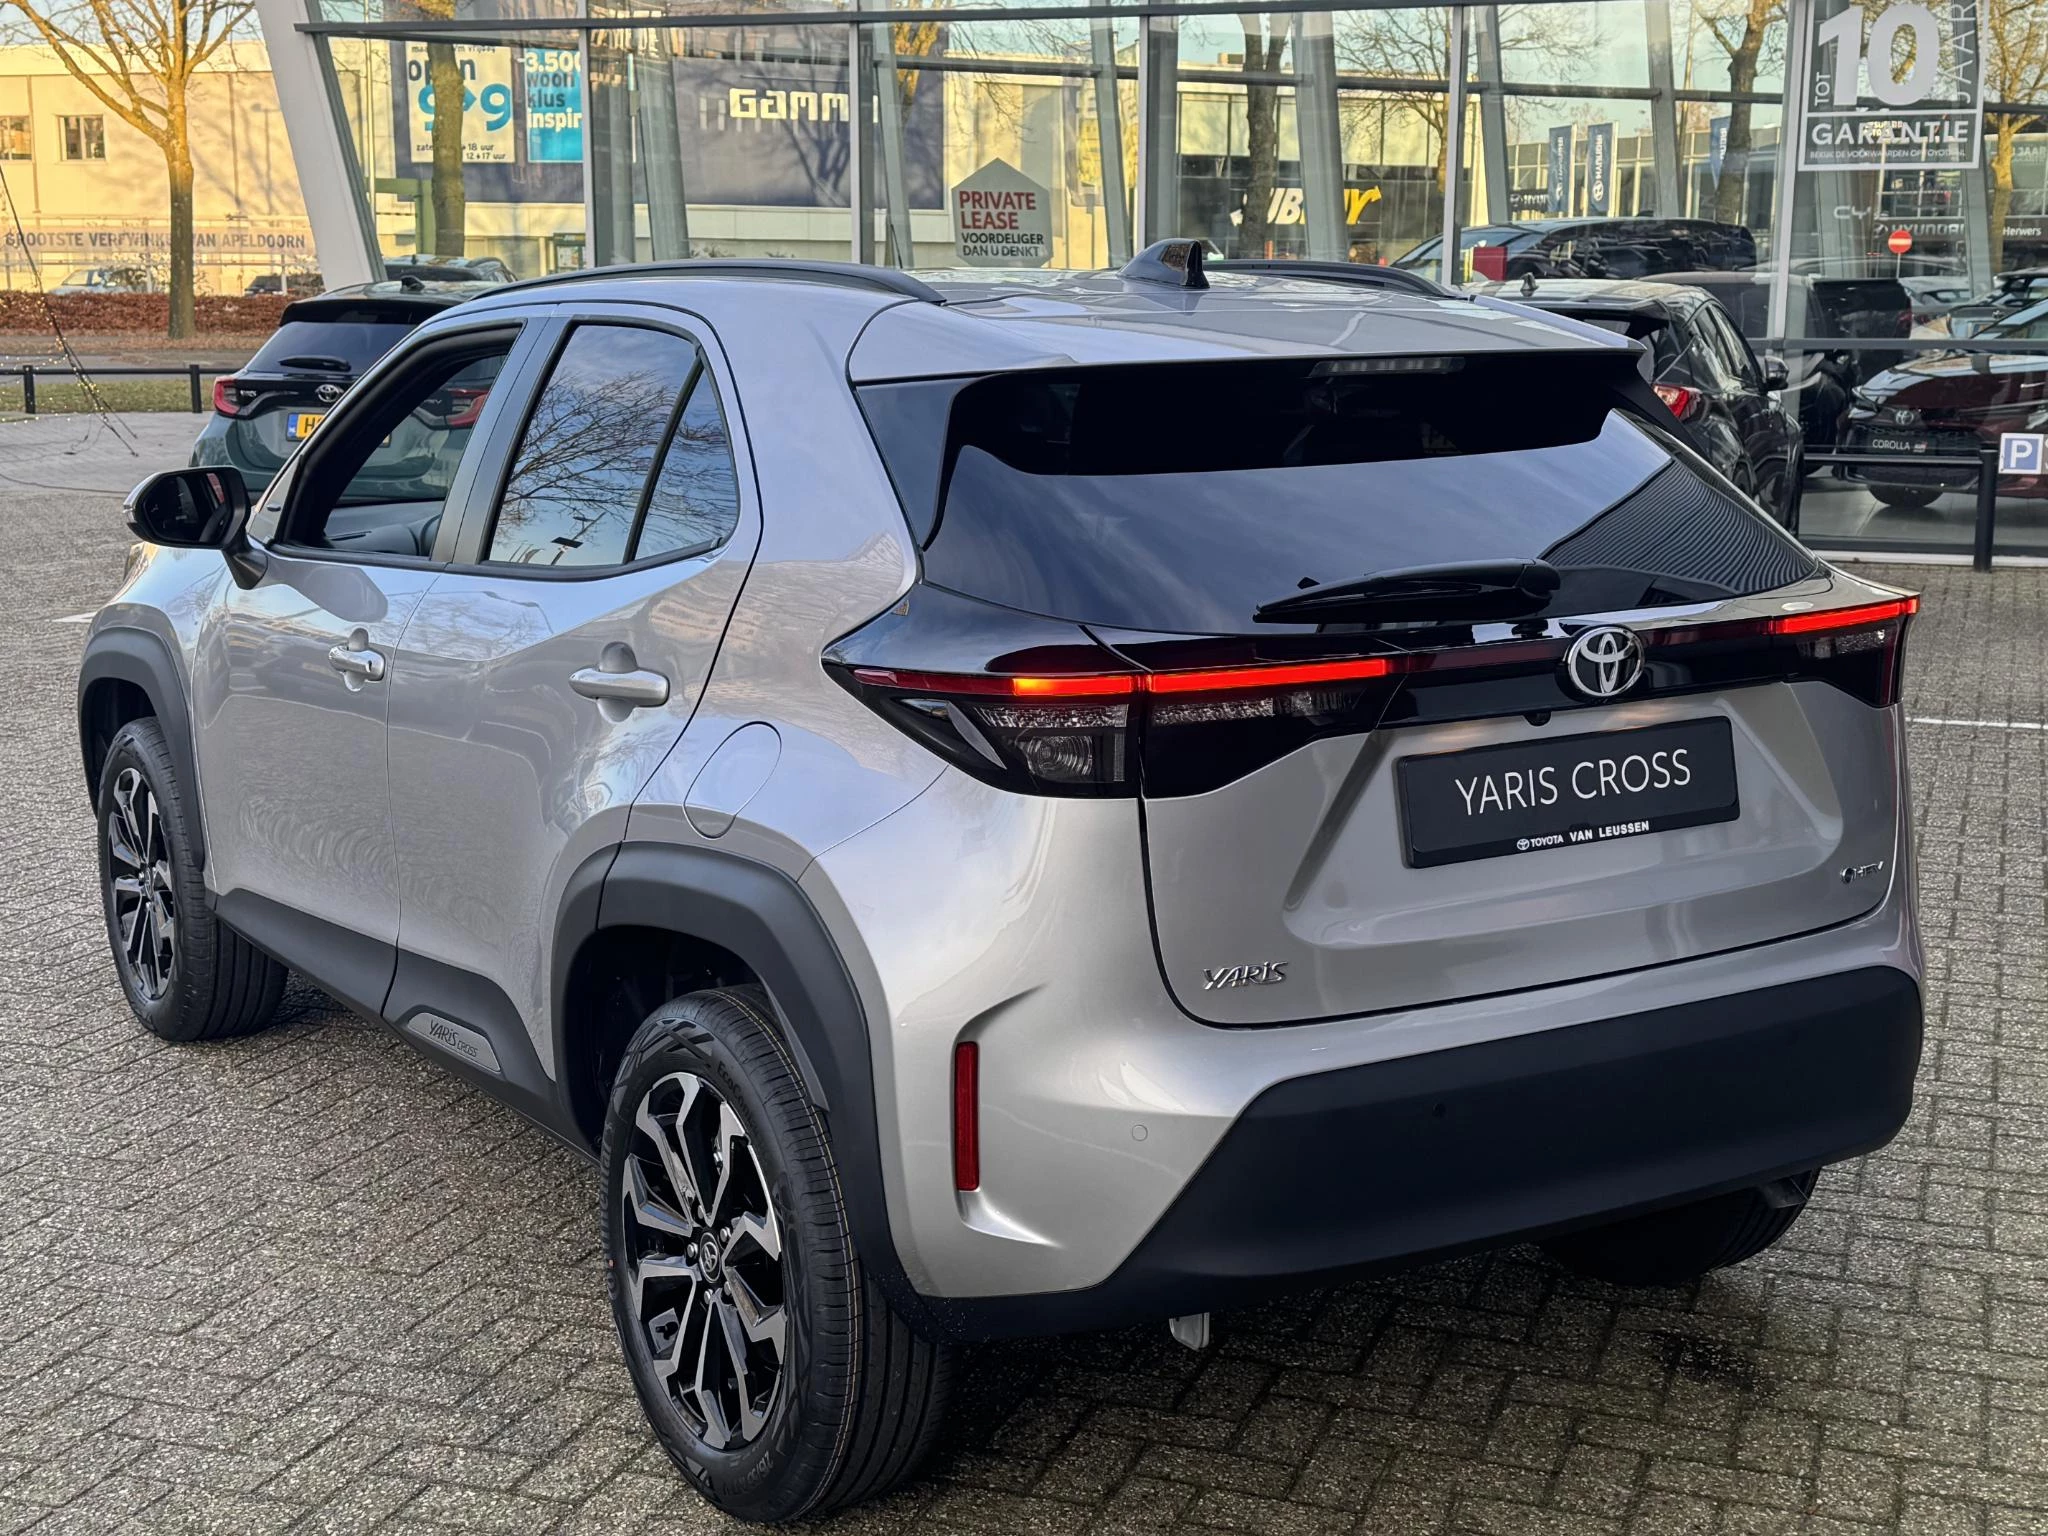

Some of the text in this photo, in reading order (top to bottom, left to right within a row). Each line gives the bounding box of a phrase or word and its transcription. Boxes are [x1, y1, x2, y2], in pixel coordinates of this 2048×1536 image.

[1818, 2, 1940, 106] 10
[1937, 0, 1976, 103] JAAR
[1815, 72, 1831, 107] TOT
[480, 83, 512, 132] 9
[729, 87, 878, 124] GAMM
[1811, 120, 1969, 145] GARANTIE
[959, 190, 1037, 211] PRIVATE
[961, 211, 1020, 230] LEASE
[221, 233, 306, 249] APELDOORN
[961, 232, 1045, 245] VOORDELIGER
[962, 244, 1041, 257] DAN U DENKT
[1872, 438, 1911, 451] COROLLA
[2009, 439, 2033, 468] P
[1454, 748, 1691, 816] YARIS CROSS
[1530, 820, 1650, 848] TOYOTA VAN LEUSSEN
[1203, 961, 1288, 990] YARIS
[429, 1019, 459, 1047] YARIS
